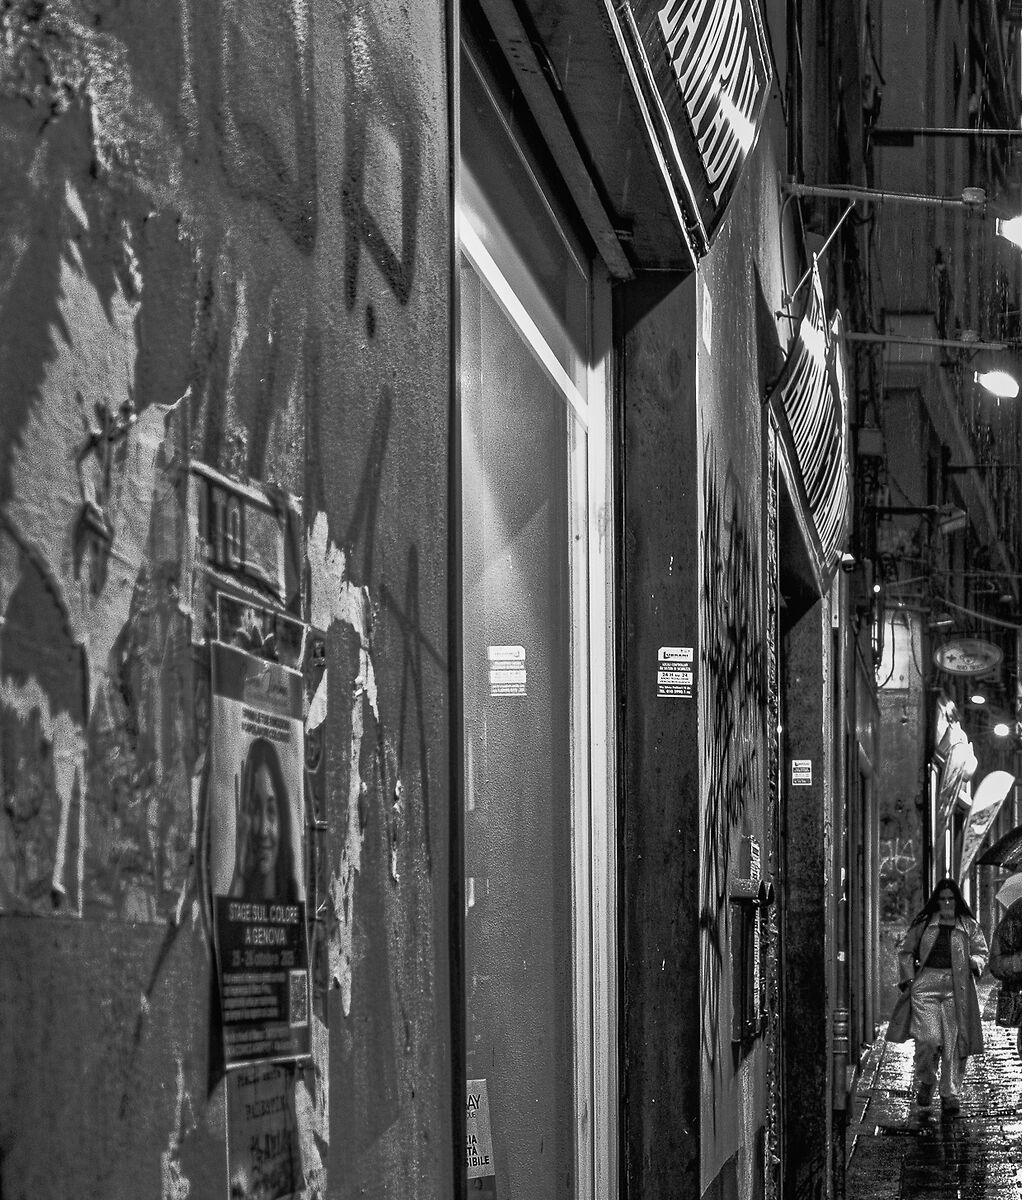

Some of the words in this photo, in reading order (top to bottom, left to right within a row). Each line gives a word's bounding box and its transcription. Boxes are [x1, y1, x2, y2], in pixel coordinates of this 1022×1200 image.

[229, 903, 250, 922] STAGE
[252, 904, 268, 922] SUL
[269, 905, 299, 924] COLORE
[252, 927, 287, 945] GENOVA
[466, 1093, 480, 1109] AY
